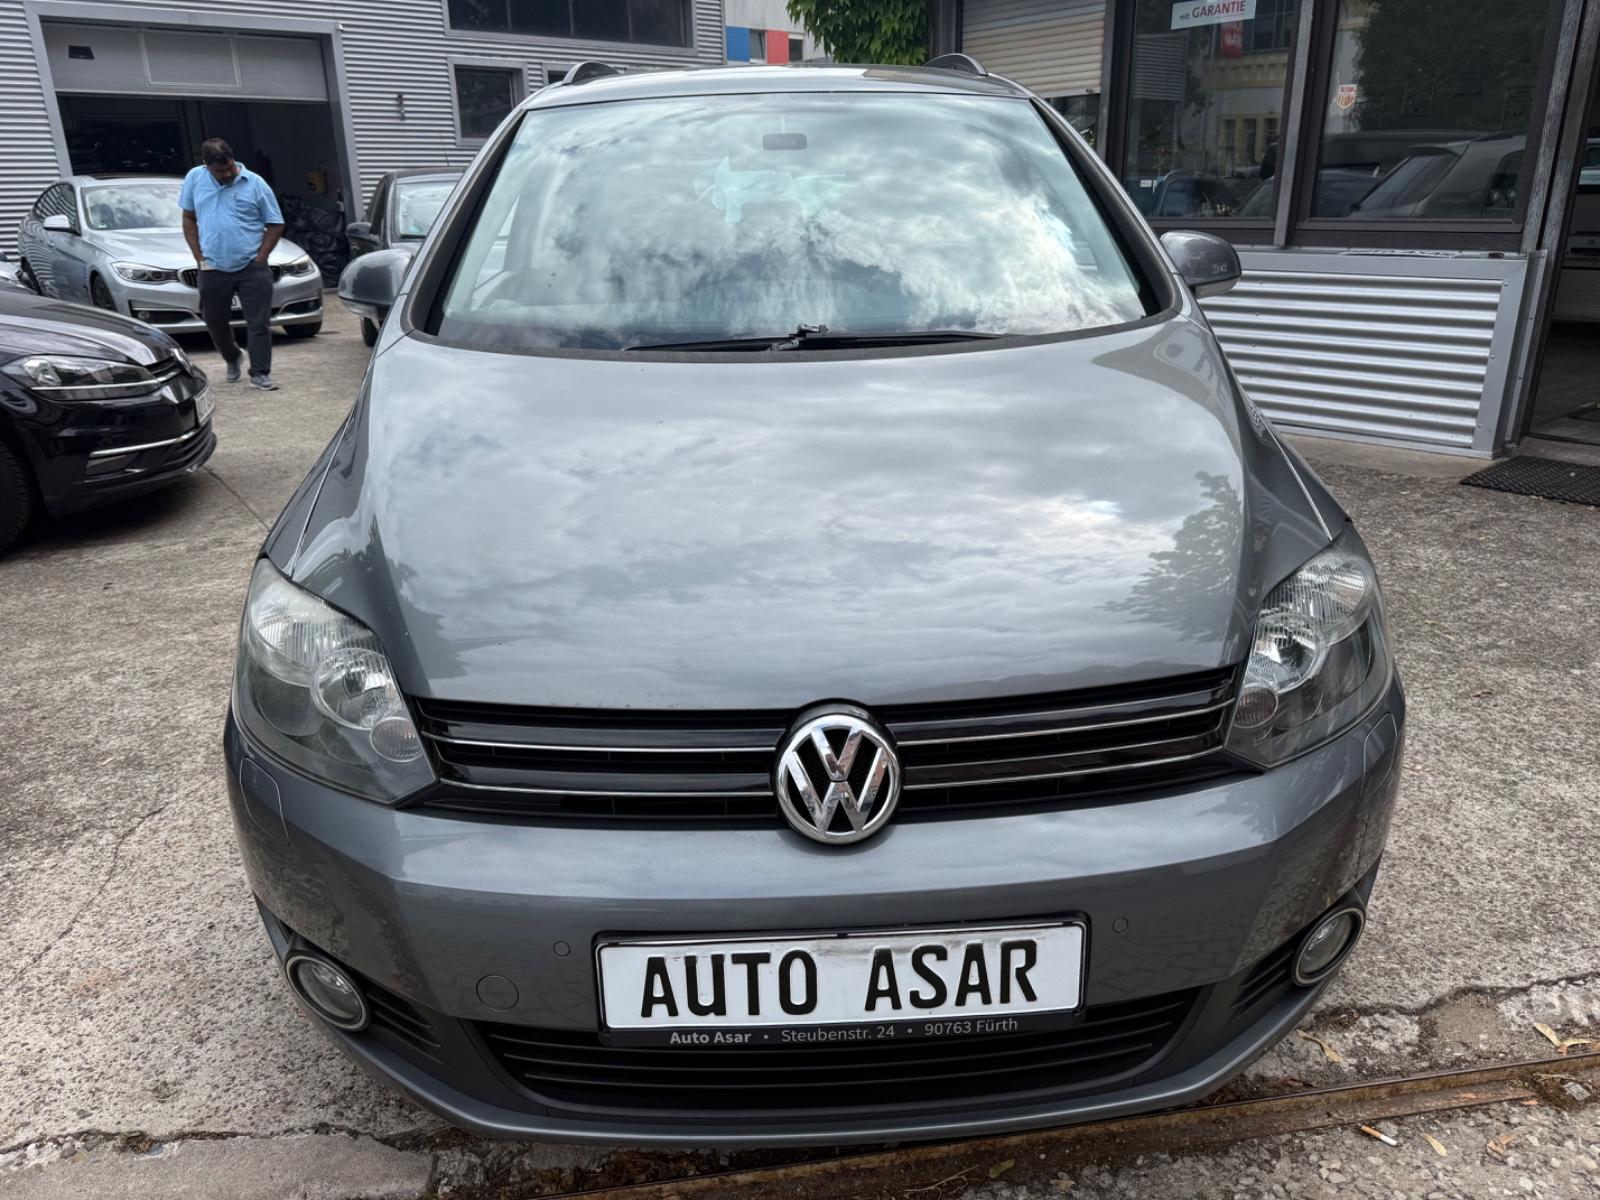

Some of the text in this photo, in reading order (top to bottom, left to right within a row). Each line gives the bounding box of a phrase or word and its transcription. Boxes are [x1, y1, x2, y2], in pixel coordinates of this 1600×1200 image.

[1192, 0, 1246, 18] GARANTIE
[641, 939, 1038, 1018] AUTO ASAR
[669, 1018, 1018, 1044] Auto Asar Steubenstr. 24 90763 Fürth
